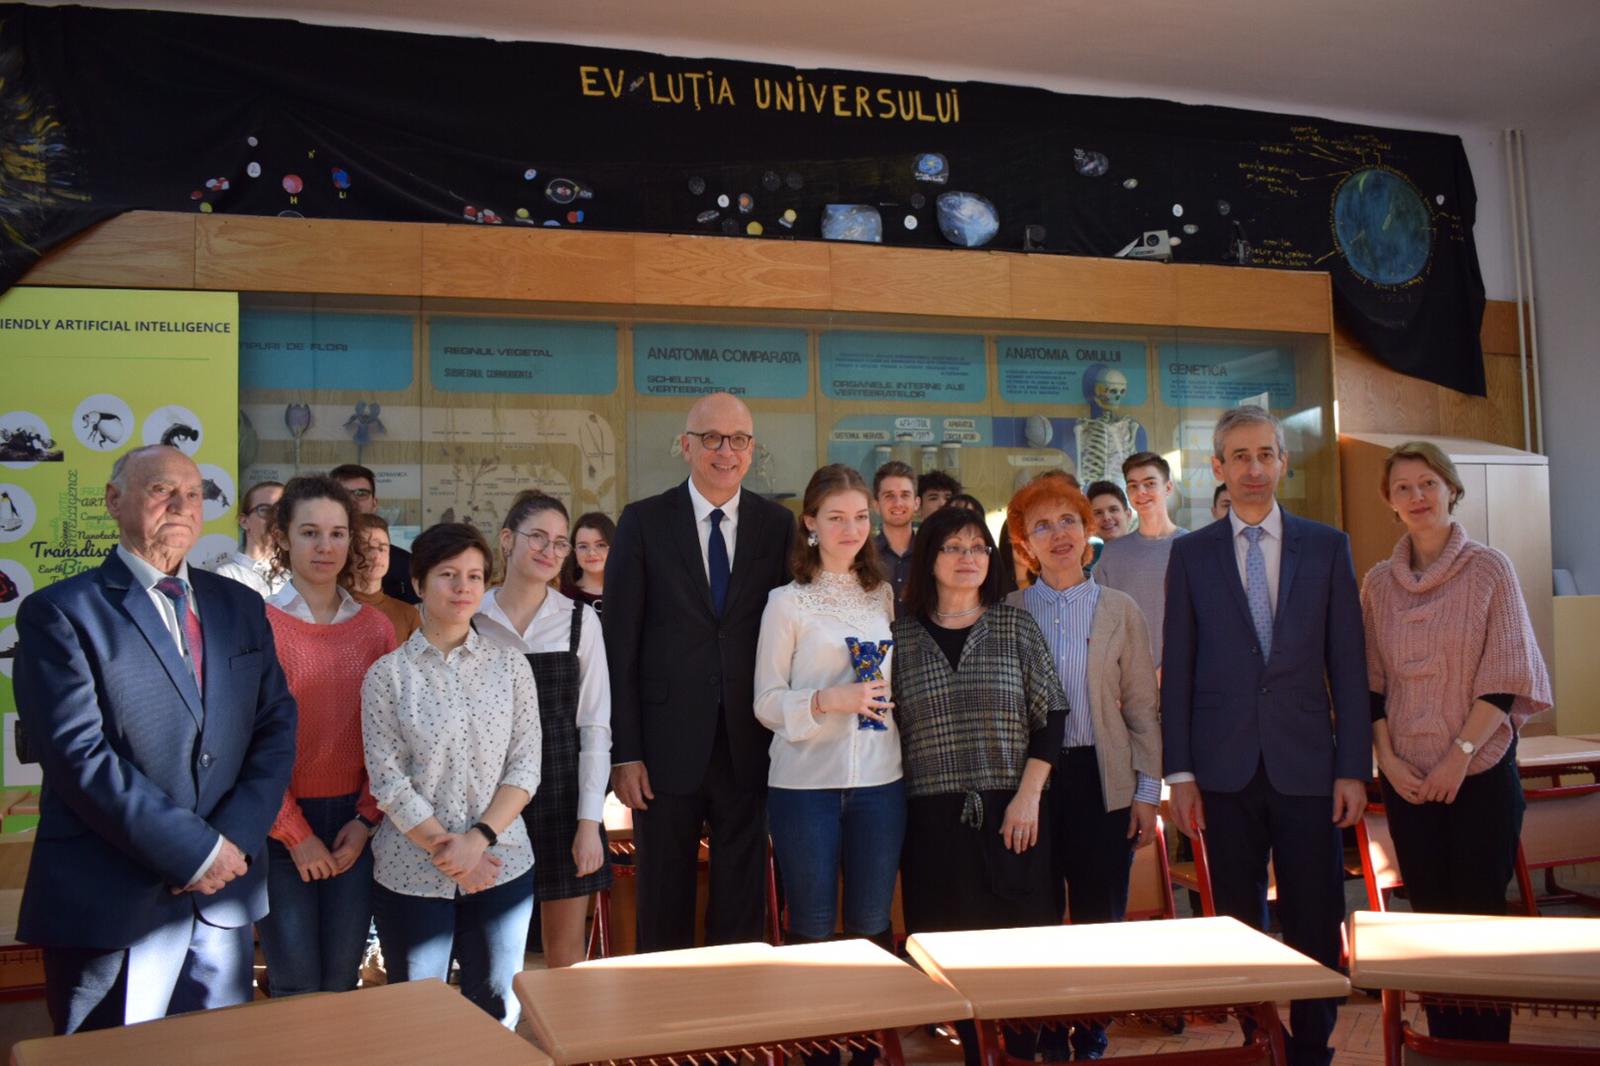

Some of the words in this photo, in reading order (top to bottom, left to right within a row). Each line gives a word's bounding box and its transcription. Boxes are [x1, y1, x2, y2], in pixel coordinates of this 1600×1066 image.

[54, 319, 131, 331] ARTIFICIAL
[135, 321, 231, 333] INTELLIGENCE
[286, 342, 304, 351] DE
[310, 342, 348, 352] FLORI
[496, 347, 553, 358] VEGETAL
[647, 347, 719, 361] ANATOMIA
[722, 348, 802, 364] COMPARATA
[1005, 347, 1070, 361] ANATOMIA
[1076, 348, 1121, 362] OMULUI
[1169, 363, 1228, 377] GENETICA
[647, 375, 714, 384] SCHELETUL
[832, 380, 893, 391] ORGANELE
[896, 381, 942, 391] INTERNE
[945, 381, 965, 391] ALE
